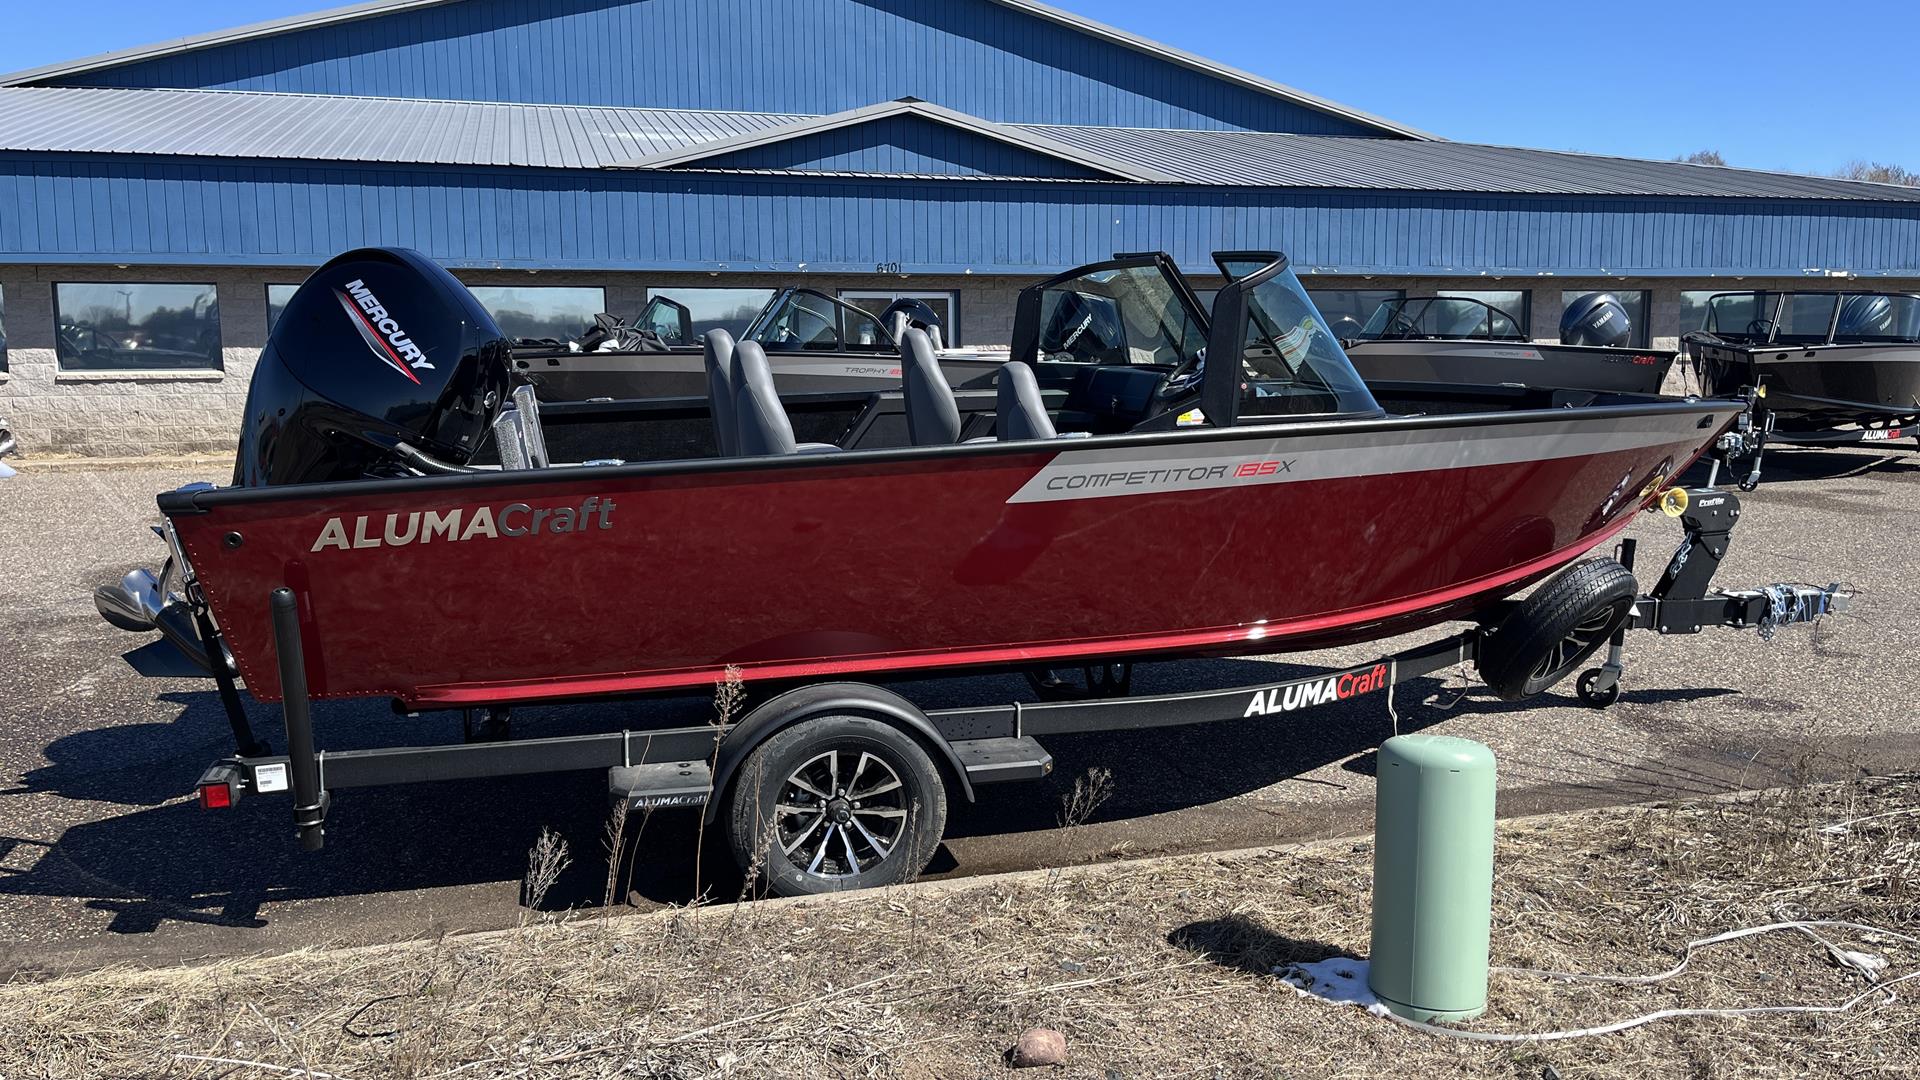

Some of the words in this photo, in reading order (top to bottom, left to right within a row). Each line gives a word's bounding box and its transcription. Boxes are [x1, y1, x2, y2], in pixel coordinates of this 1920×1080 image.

[876, 262, 902, 273] 6701
[345, 279, 436, 370] MERCURY
[1063, 313, 1093, 350] MERCURY
[1592, 310, 1614, 329] YAMAHA
[845, 367, 888, 375] TROPHY
[1047, 465, 1228, 491] COMPETITOR
[1232, 459, 1297, 478] 185X
[311, 496, 617, 552] ALUMACraft
[1243, 664, 1388, 718] ALUMACraft
